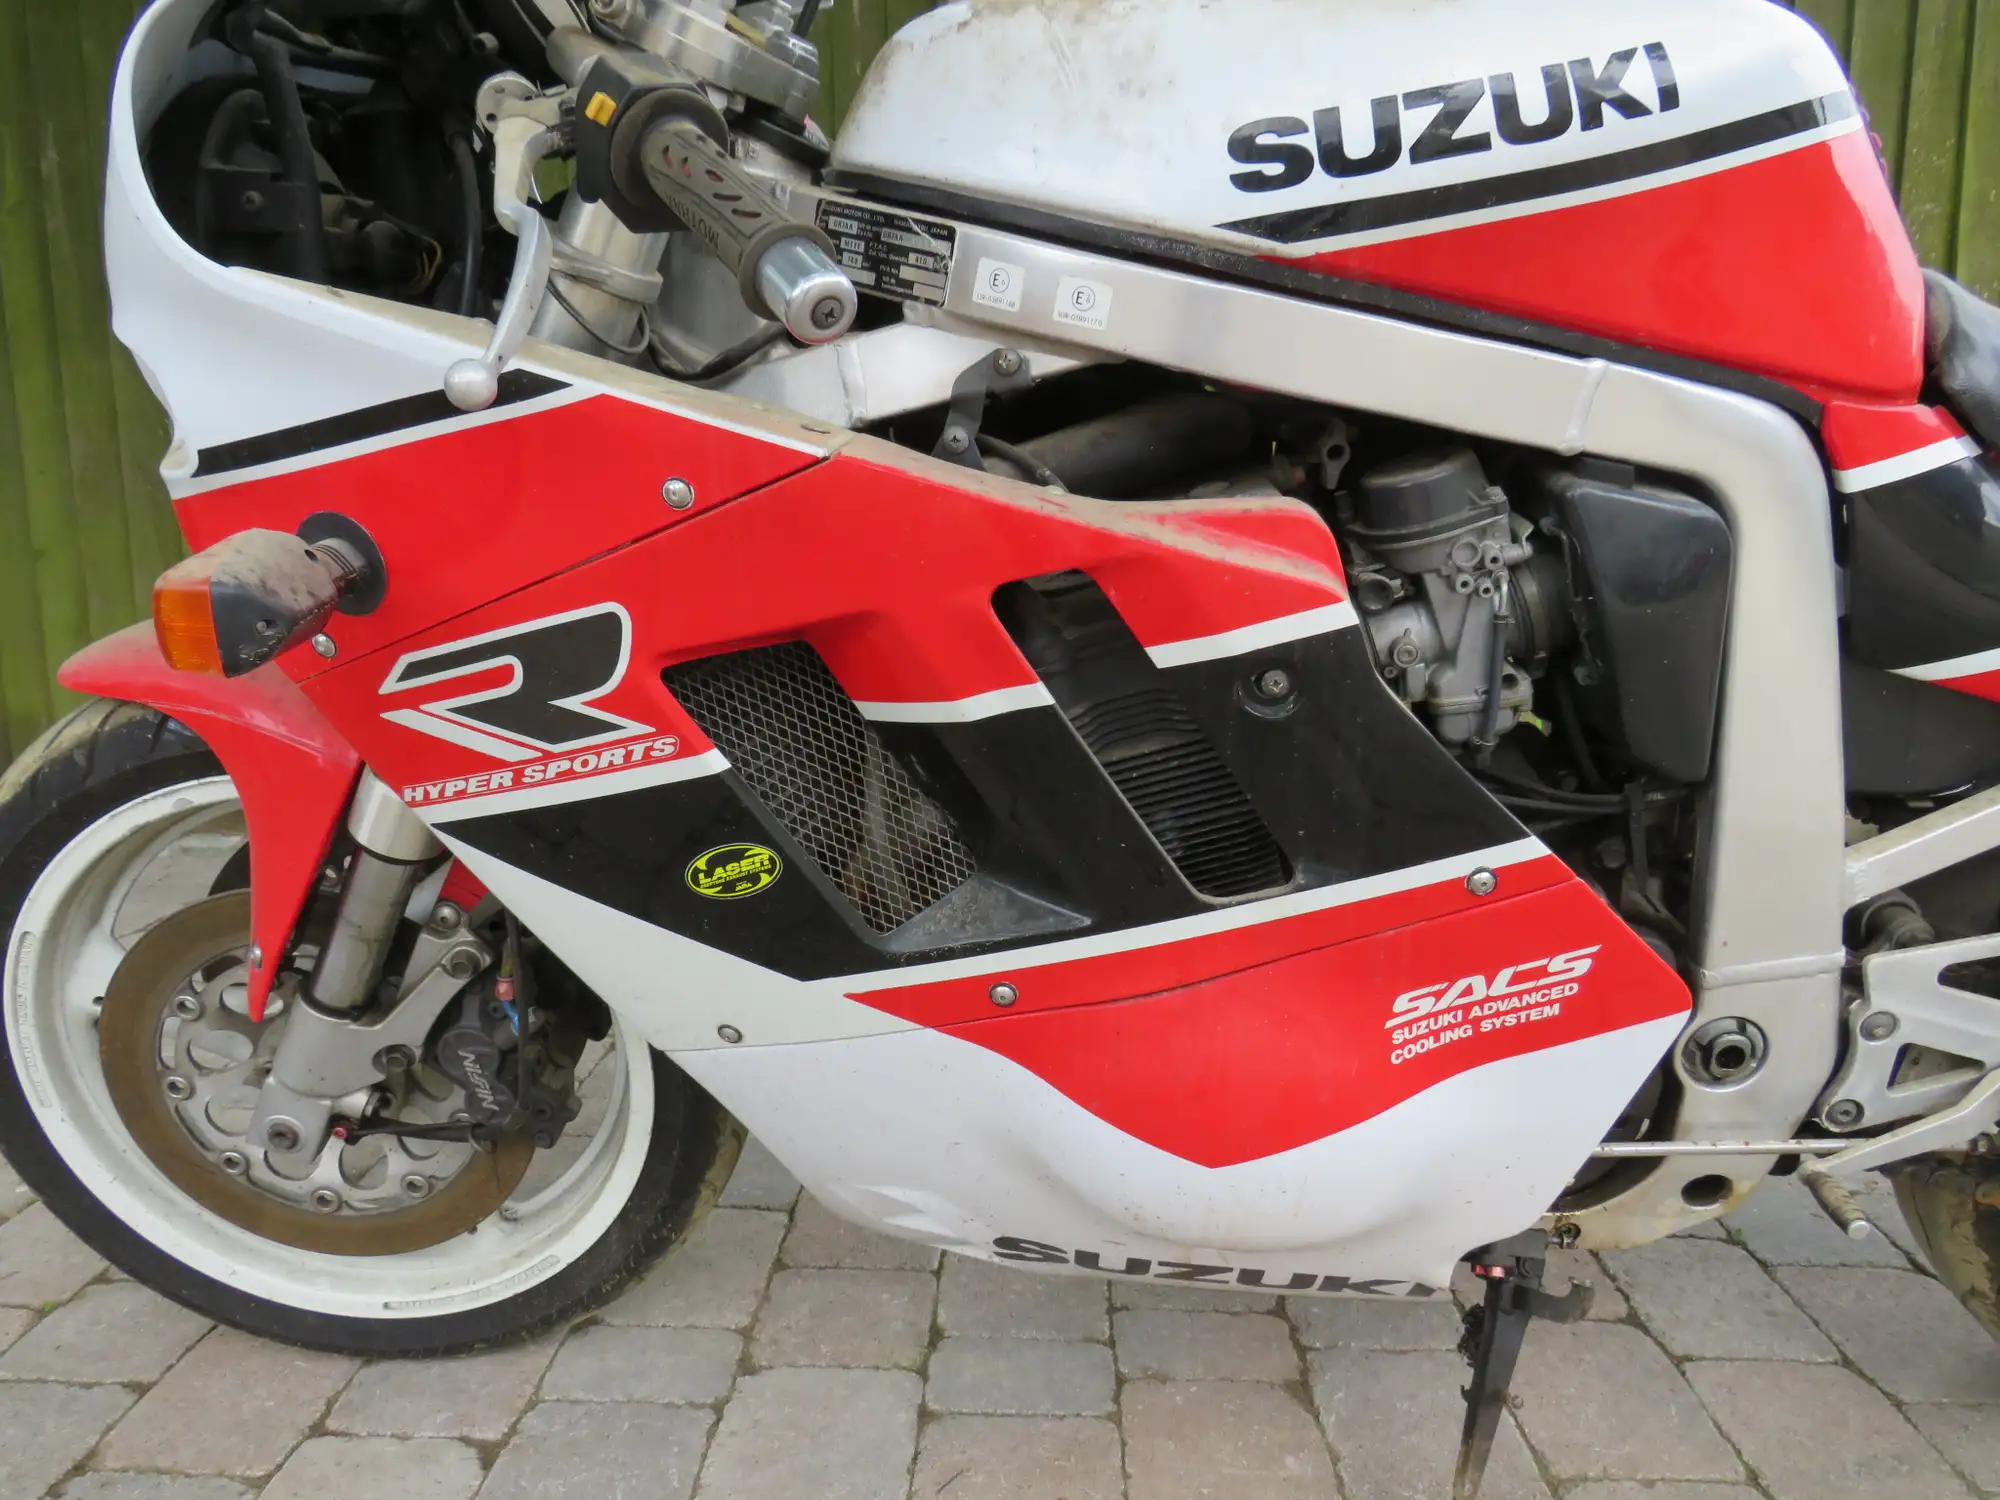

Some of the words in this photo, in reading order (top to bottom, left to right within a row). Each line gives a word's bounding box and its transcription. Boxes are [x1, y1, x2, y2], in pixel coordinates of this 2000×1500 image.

[1227, 41, 1680, 193] SUZUKI
[844, 207, 862, 218] MOTOR
[403, 771, 513, 802] HYPER
[522, 737, 678, 784] SPORTS
[698, 854, 770, 884] LASER
[1384, 944, 1602, 1029] SACS
[1392, 1010, 1462, 1045] SUZUKI
[1468, 982, 1579, 1020] ADVANCED
[1390, 1024, 1473, 1065] COOLING
[1479, 1002, 1560, 1032] SYSTEM
[992, 1235, 1438, 1298] SUZUKI
